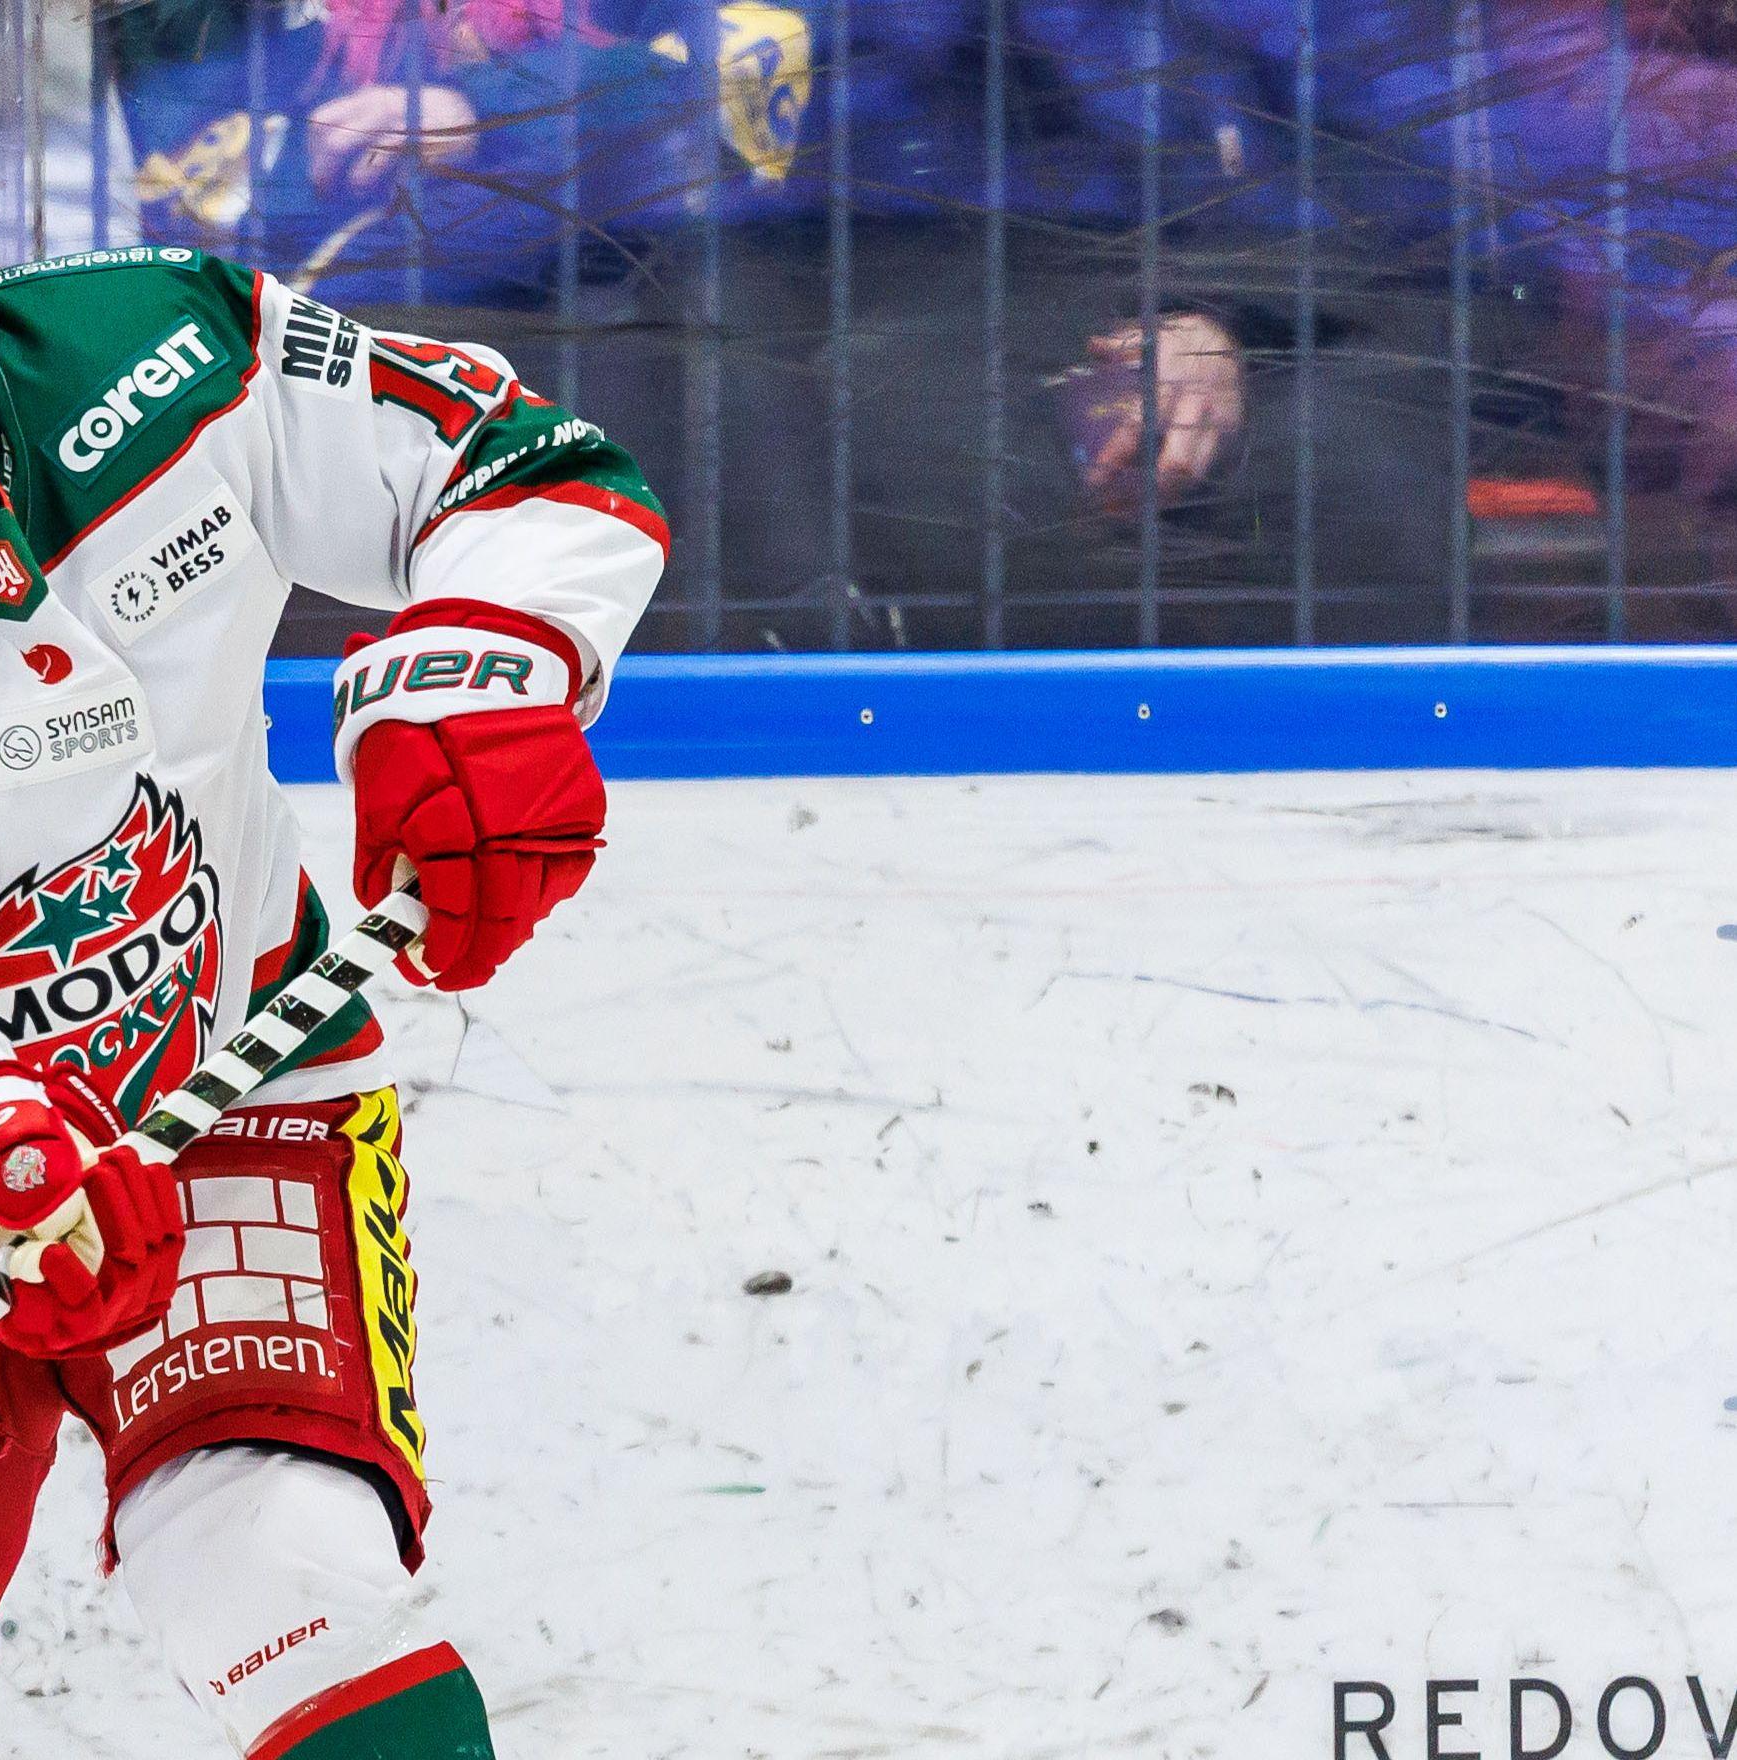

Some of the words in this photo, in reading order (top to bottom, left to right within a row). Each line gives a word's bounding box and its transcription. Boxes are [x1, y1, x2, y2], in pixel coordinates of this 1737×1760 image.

[150, 505, 232, 570] VIMAB
[166, 543, 225, 593] BESS
[46, 697, 135, 739] SYNSAM
[50, 719, 139, 762] SPORTS
[48, 934, 205, 1076] OCKEY
[113, 1335, 336, 1433] Lerstenen.
[1333, 1675, 1737, 1760] REDOV
